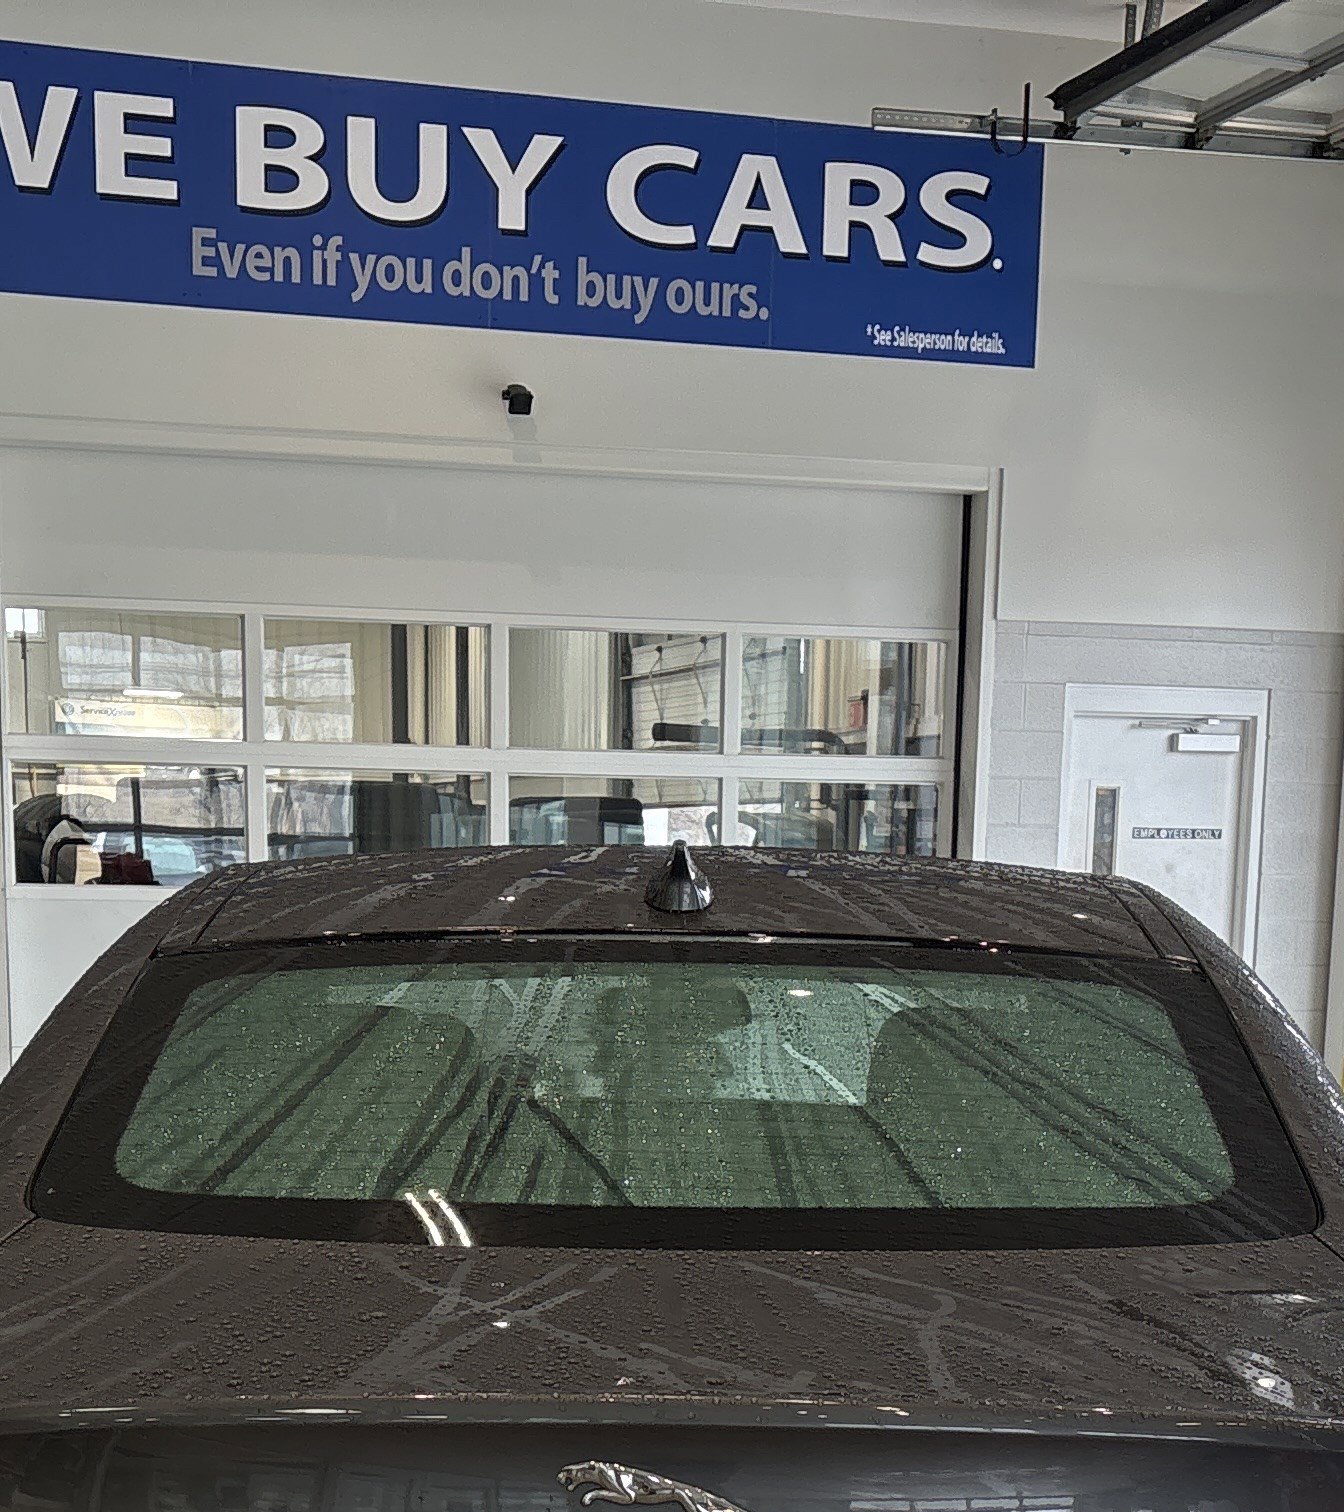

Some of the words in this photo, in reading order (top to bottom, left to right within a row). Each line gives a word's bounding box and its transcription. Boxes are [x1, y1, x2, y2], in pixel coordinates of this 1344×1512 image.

[235, 105, 565, 232] BUY
[606, 144, 1003, 271] CARS.
[191, 226, 301, 284] Even
[312, 233, 344, 287] if
[348, 252, 433, 303] you
[442, 246, 560, 305] don't
[576, 256, 660, 325] buy
[666, 278, 770, 321] ours.
[893, 325, 952, 354] Salesperson
[953, 328, 969, 352] for
[969, 330, 1006, 355] details.
[1133, 828, 1193, 839] EMPLOYEES
[1194, 829, 1220, 839] ONLY
